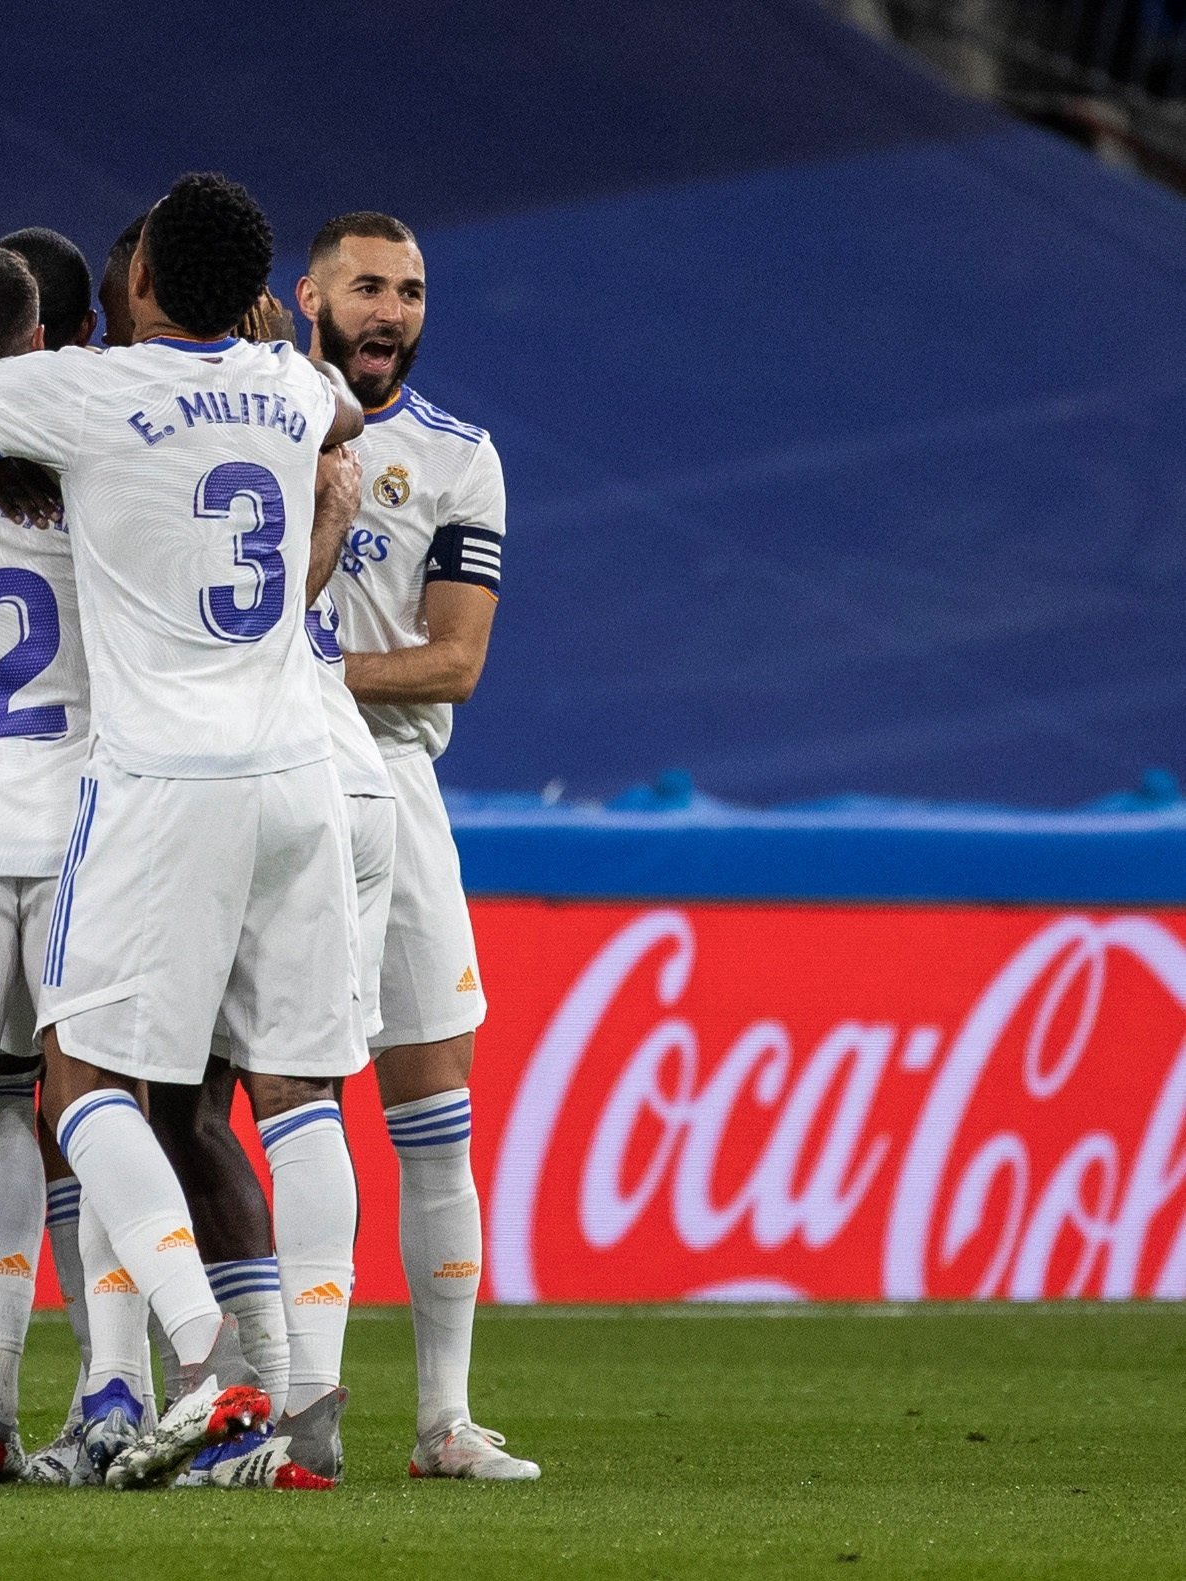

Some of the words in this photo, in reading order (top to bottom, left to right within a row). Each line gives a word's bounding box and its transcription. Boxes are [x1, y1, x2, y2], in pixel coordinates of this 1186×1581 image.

[127, 411, 175, 446] E.
[176, 391, 307, 443] MILITÃO
[194, 461, 285, 643] 3
